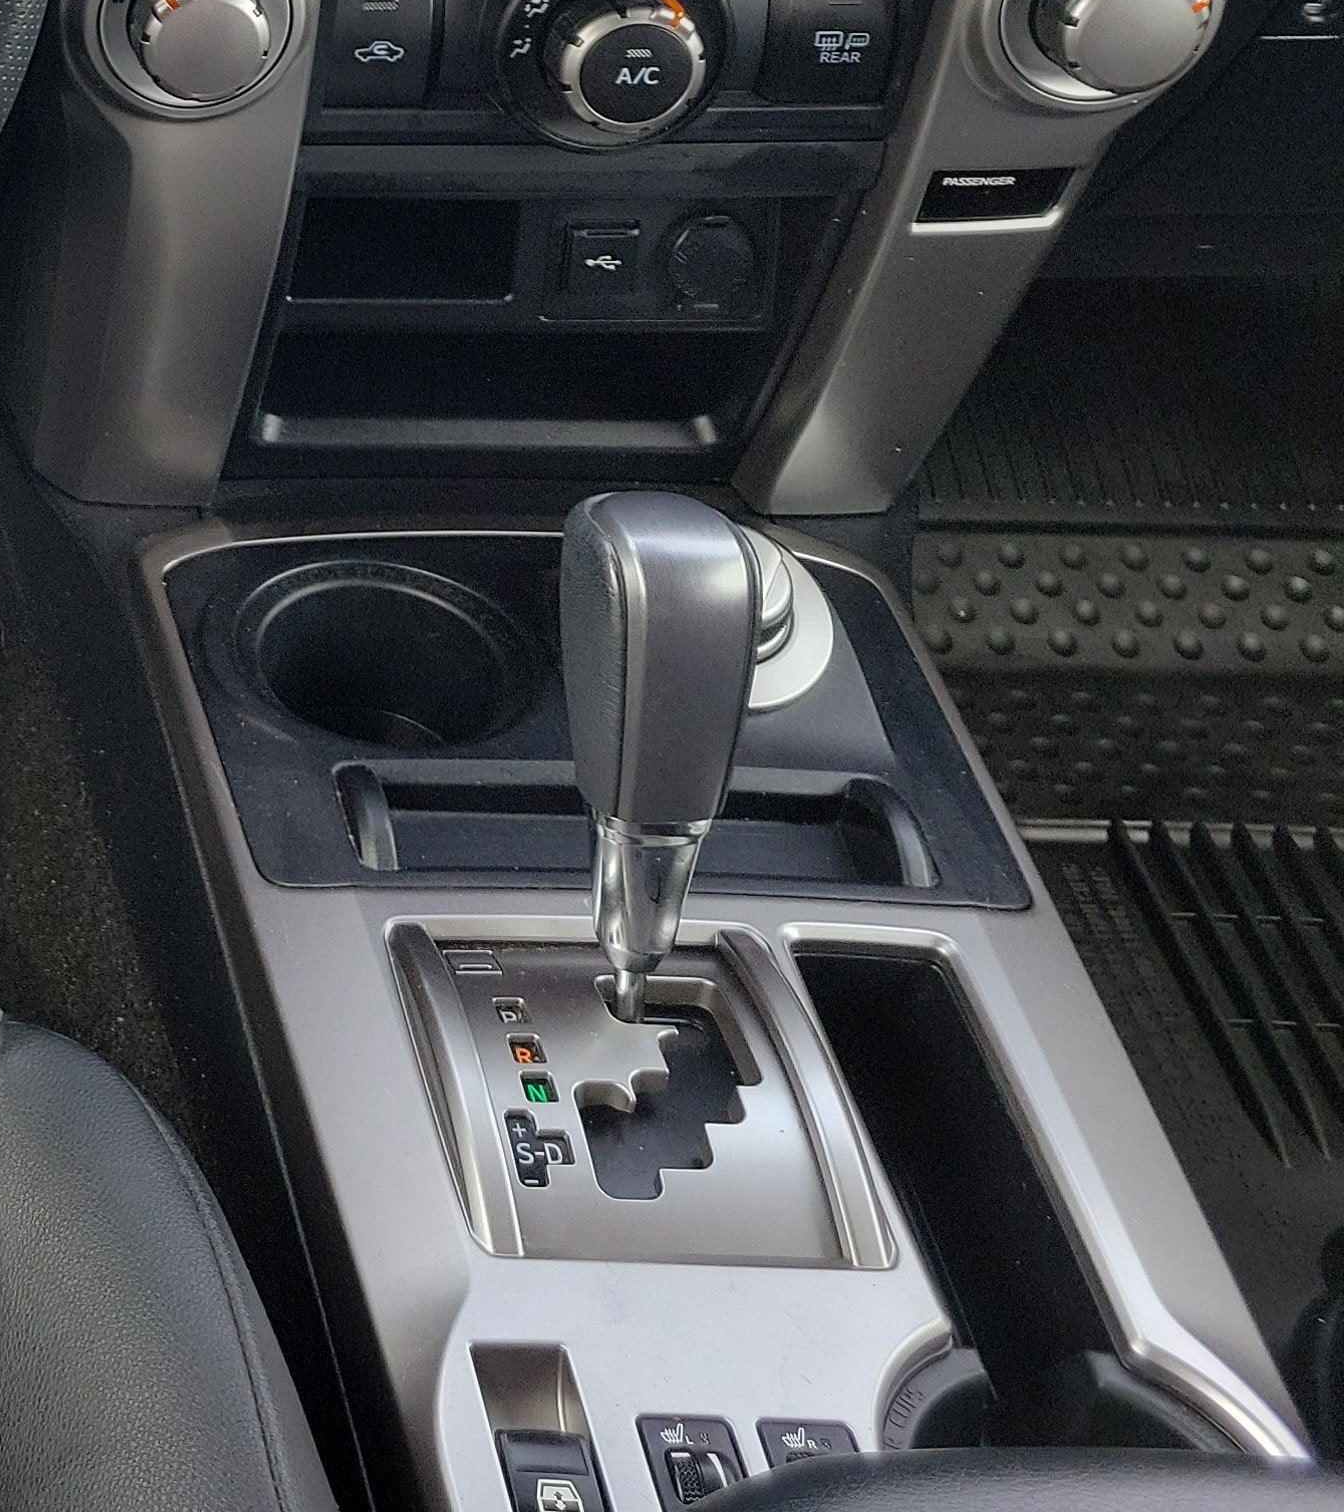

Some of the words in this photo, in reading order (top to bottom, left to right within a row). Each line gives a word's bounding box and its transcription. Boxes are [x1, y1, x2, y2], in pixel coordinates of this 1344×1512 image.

[819, 51, 861, 63] REAR
[615, 66, 661, 86] A/C
[942, 176, 1016, 187] PASSENGER
[514, 1047, 532, 1063] R
[527, 1084, 548, 1103] N
[686, 1435, 695, 1445] L
[807, 1439, 817, 1450] R
